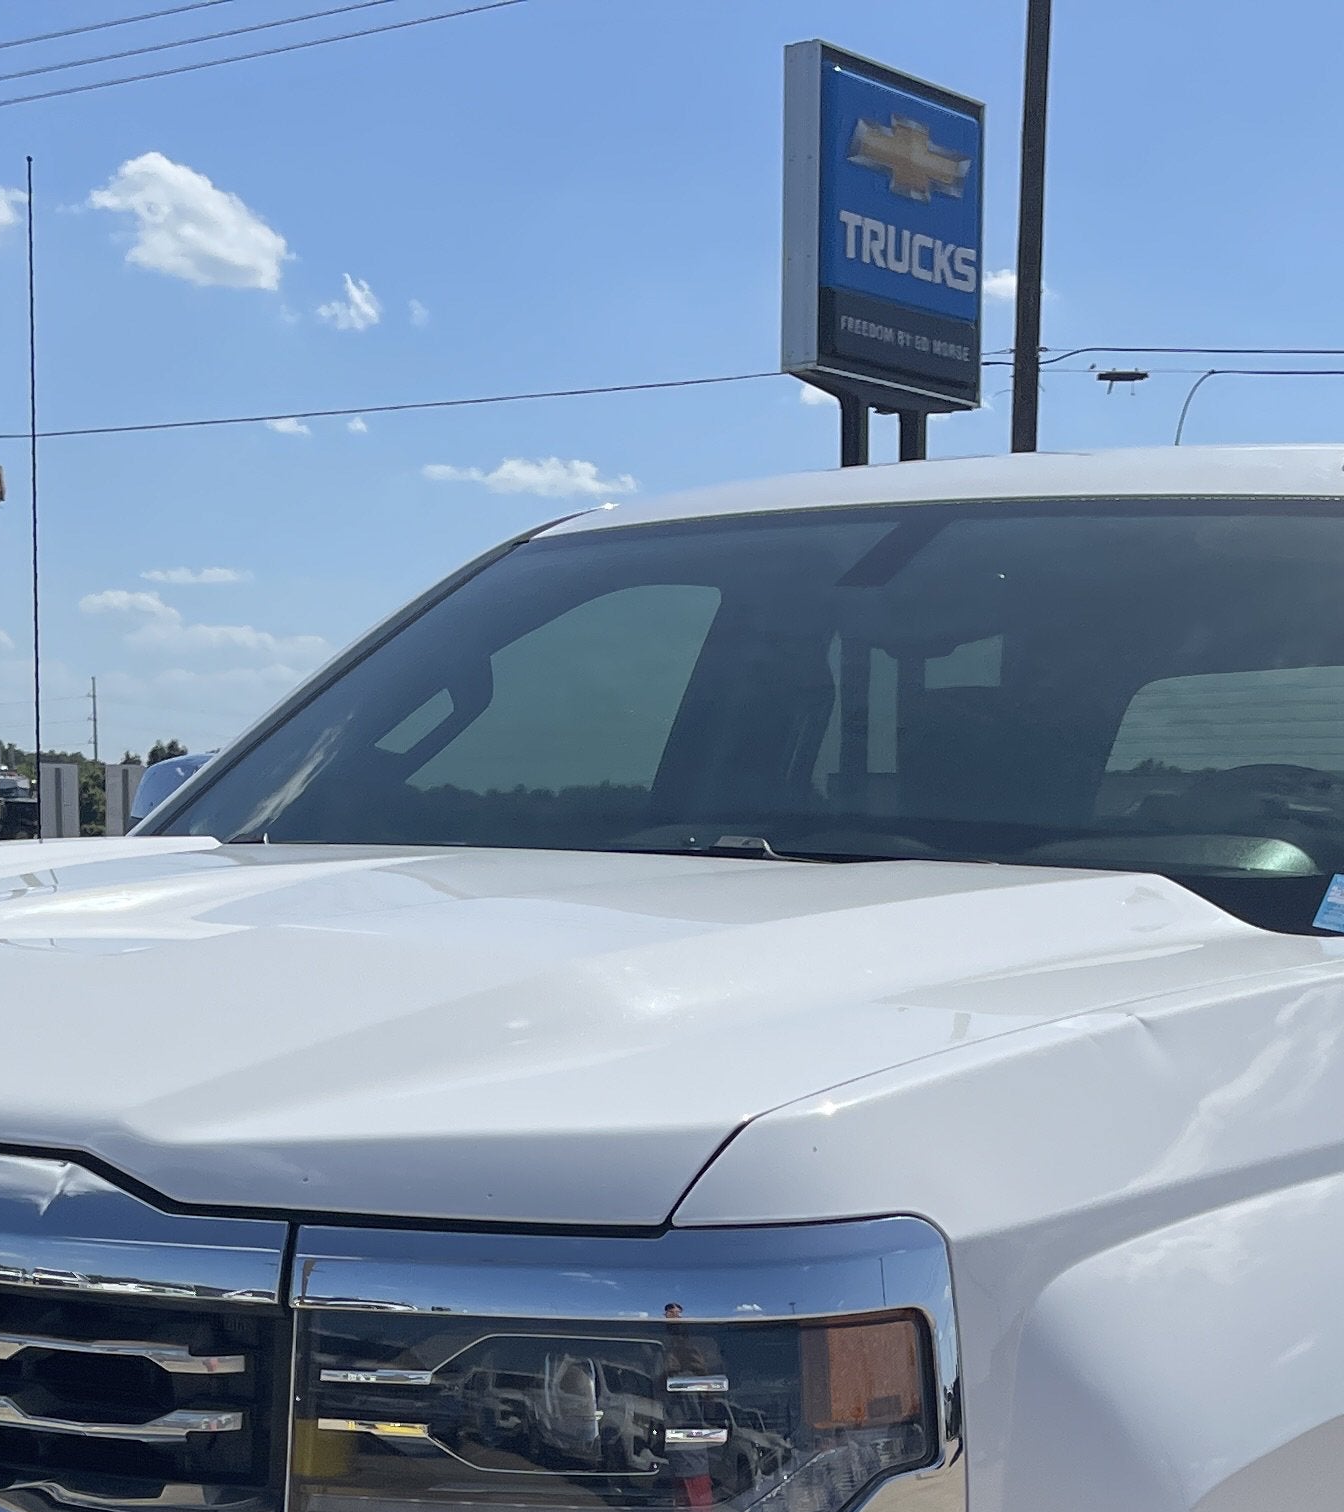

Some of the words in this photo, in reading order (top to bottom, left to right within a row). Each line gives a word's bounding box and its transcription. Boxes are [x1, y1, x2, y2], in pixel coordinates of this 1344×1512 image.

[839, 210, 977, 294] TRUCKS
[840, 315, 895, 344] FREEDOM
[897, 330, 912, 347] BY
[915, 335, 930, 352] ED
[932, 339, 971, 361] MORSE
